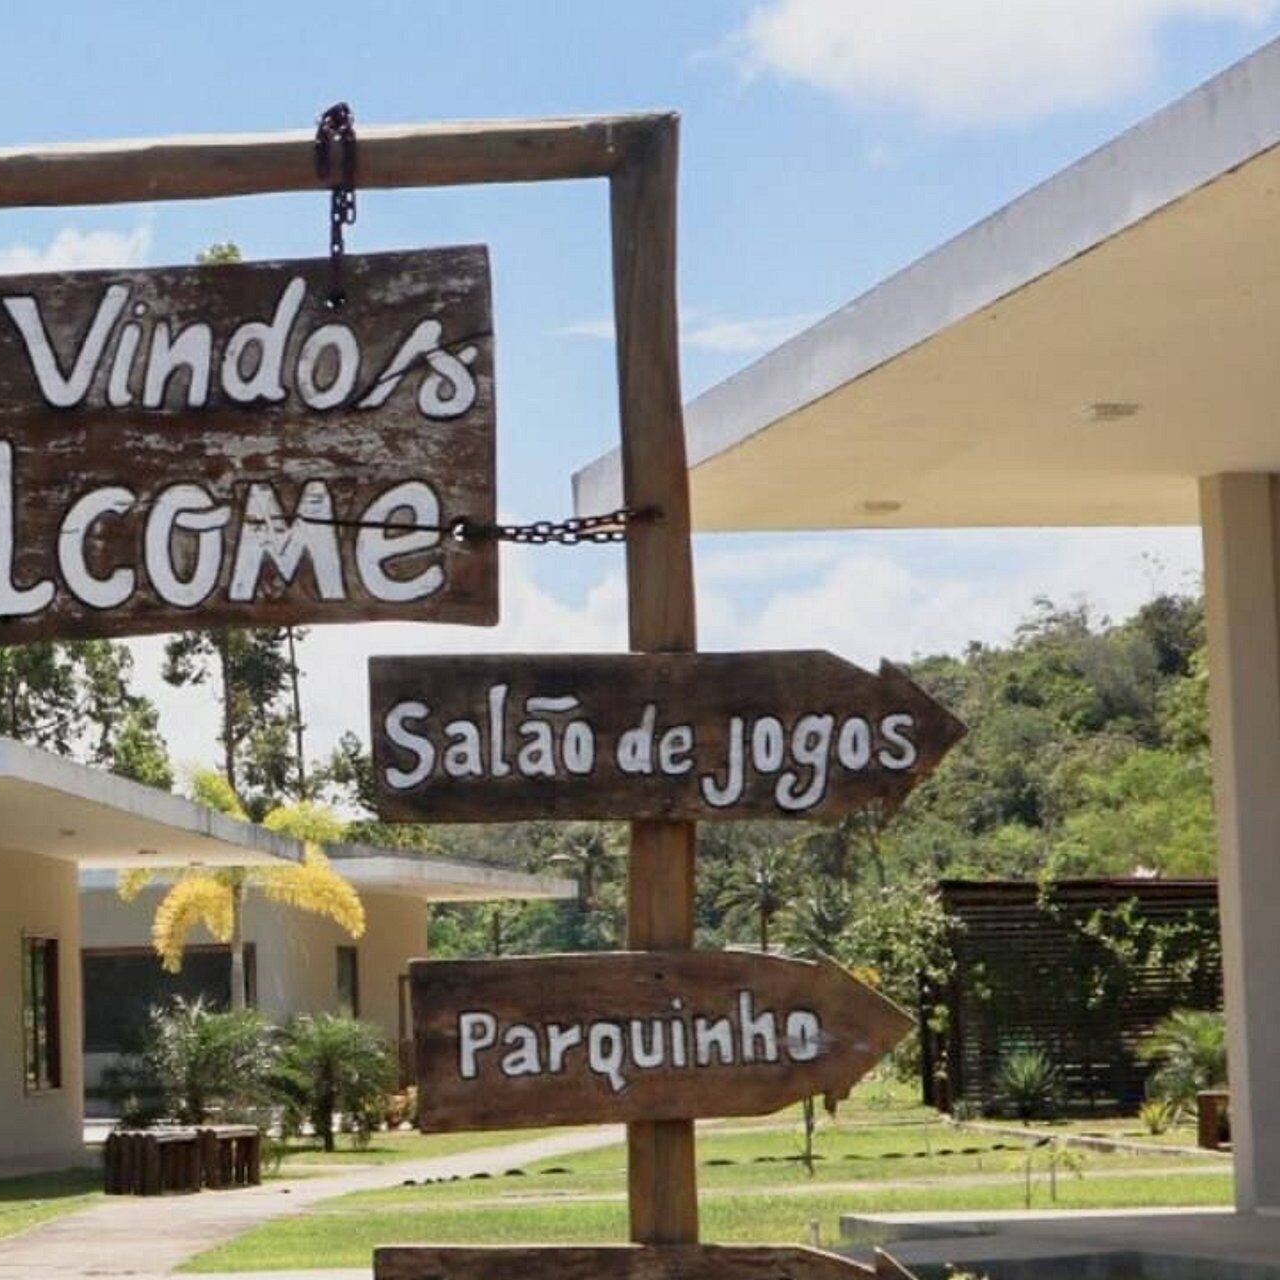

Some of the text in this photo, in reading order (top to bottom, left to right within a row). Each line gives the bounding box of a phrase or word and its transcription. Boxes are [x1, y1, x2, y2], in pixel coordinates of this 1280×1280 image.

[385, 684, 595, 789] Salão
[617, 705, 695, 774] de
[460, 991, 819, 1088] Parquinho
